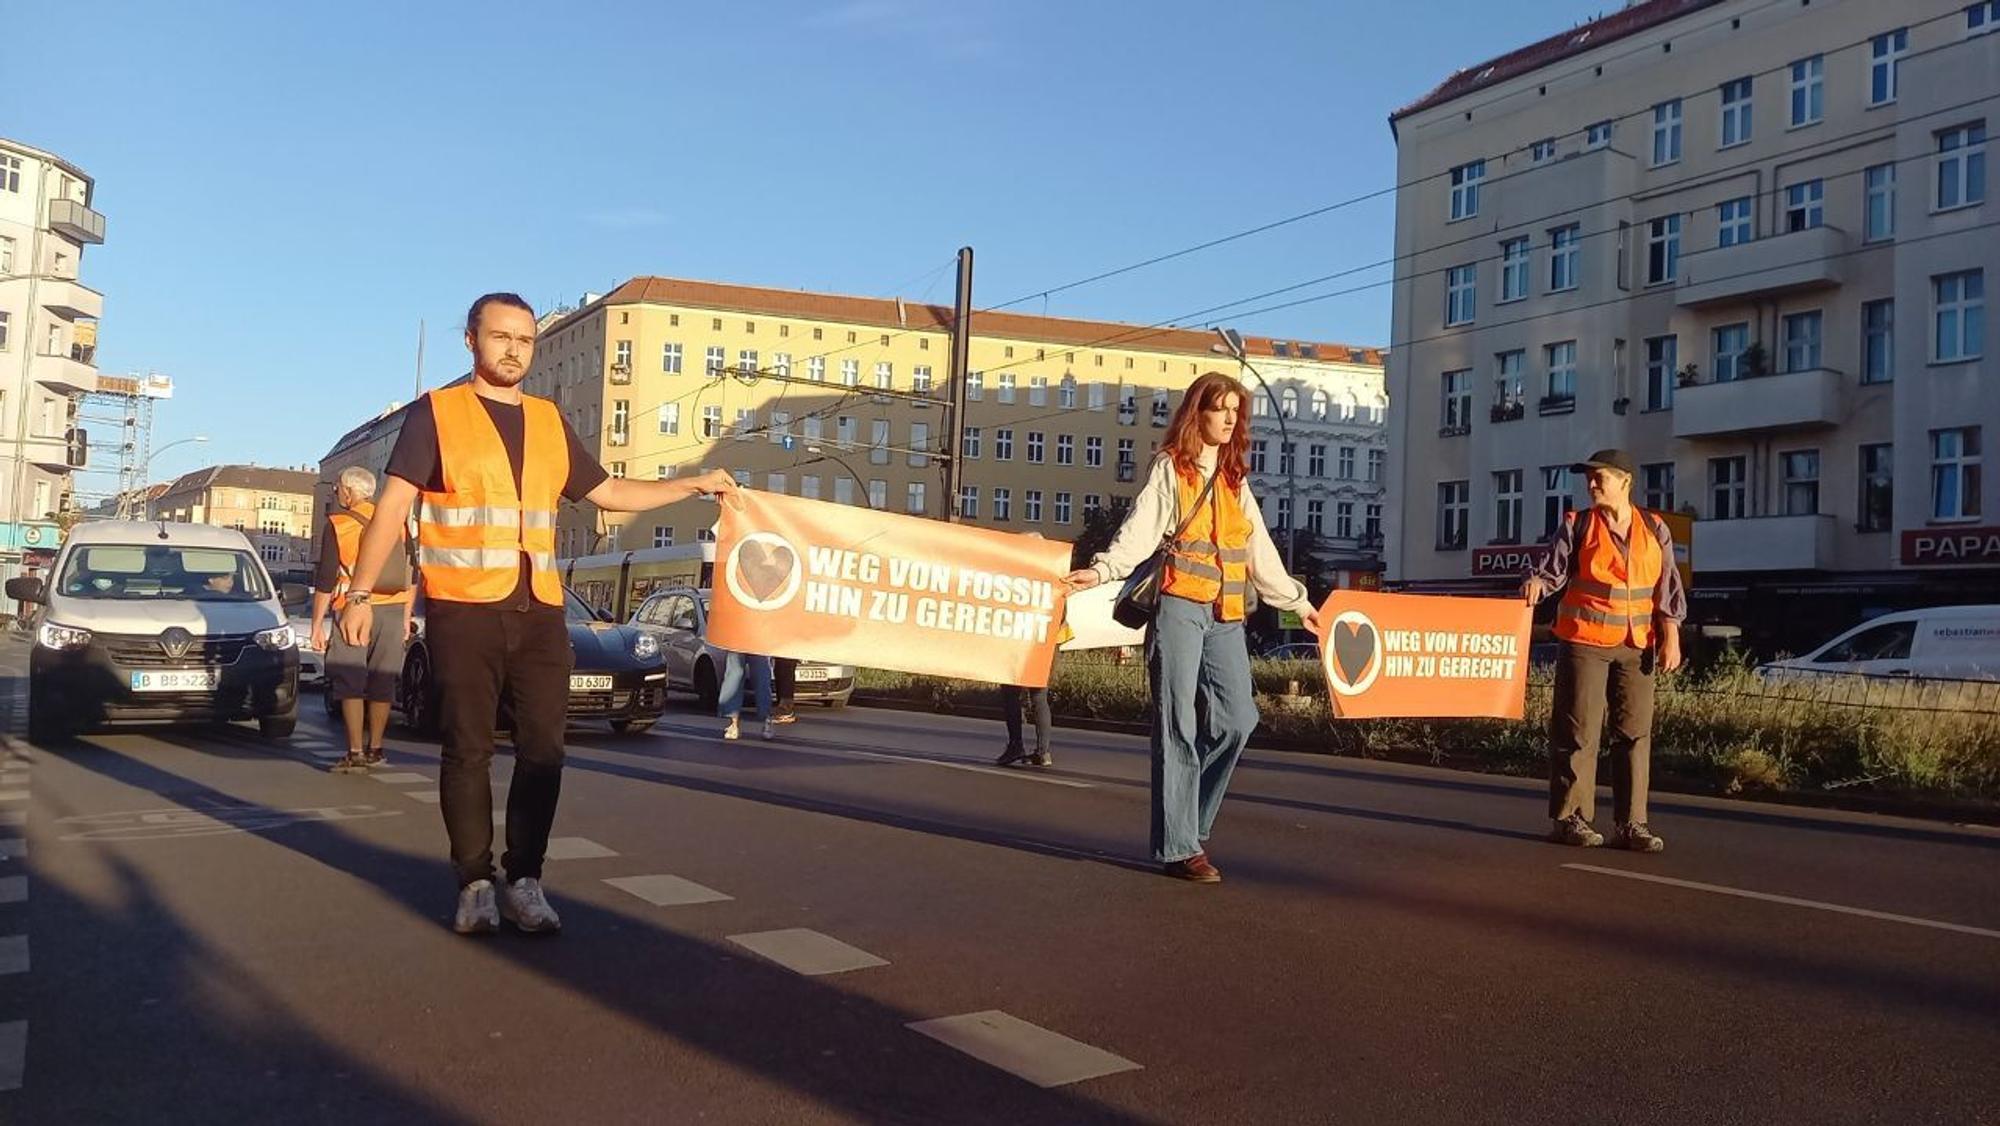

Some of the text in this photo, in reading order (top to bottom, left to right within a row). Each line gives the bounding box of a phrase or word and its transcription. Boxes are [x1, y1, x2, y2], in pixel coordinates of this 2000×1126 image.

[1915, 535, 2000, 558] PAPA
[1479, 552, 1533, 570] PAPA
[808, 546, 1054, 609] WEG VON FOSSIL
[804, 581, 1053, 643] HIN ZU GERECHT
[1384, 630, 1518, 656] WEG VON FOSSIL
[1385, 655, 1517, 679] HIN ZU GERECHT
[142, 674, 151, 687] B
